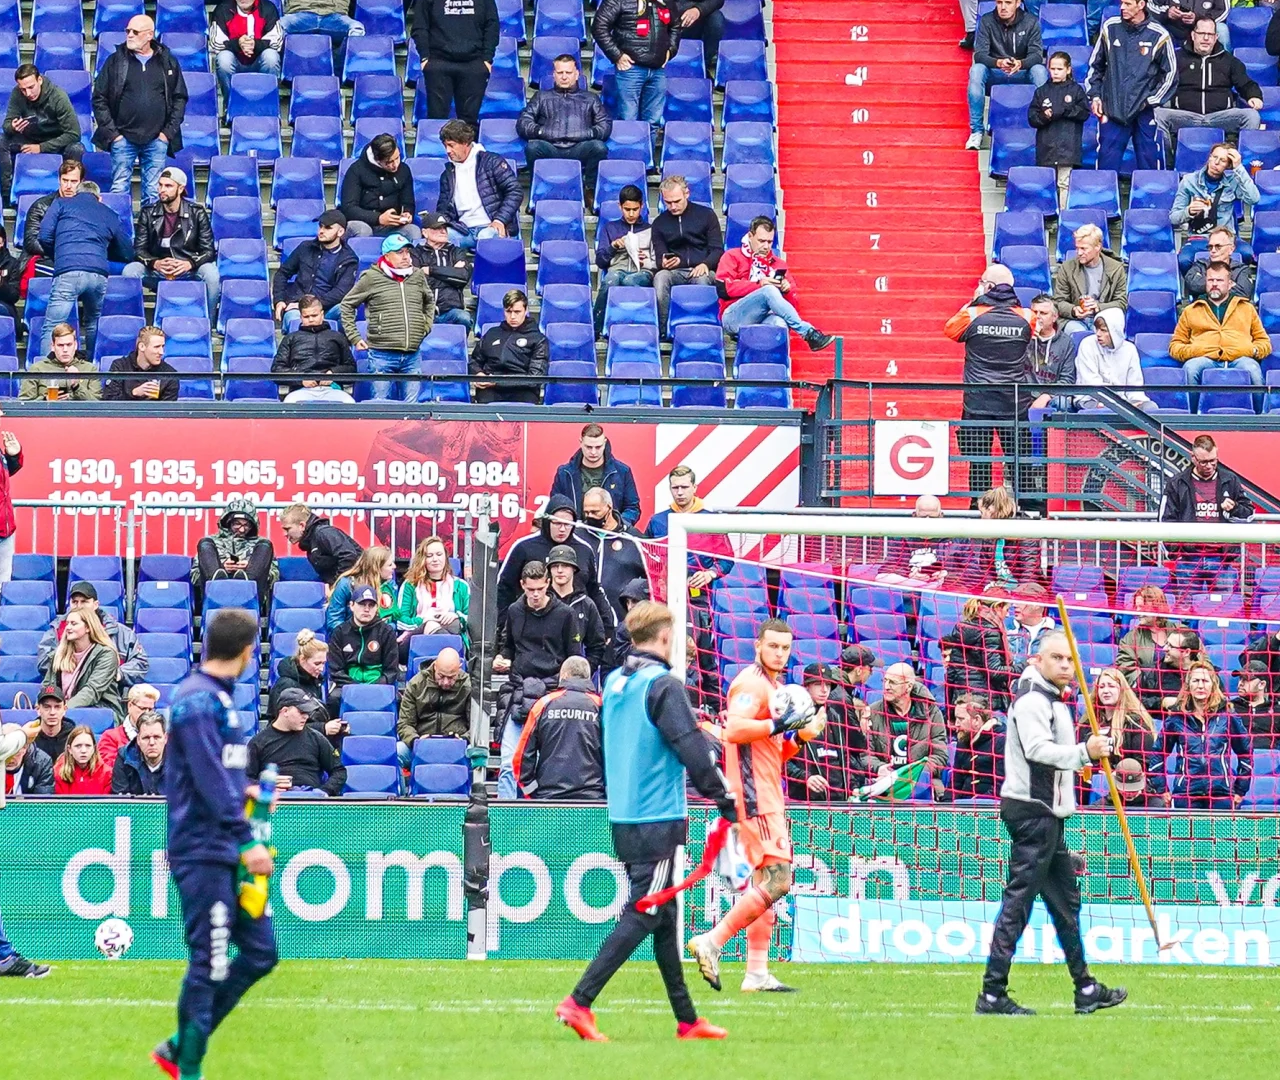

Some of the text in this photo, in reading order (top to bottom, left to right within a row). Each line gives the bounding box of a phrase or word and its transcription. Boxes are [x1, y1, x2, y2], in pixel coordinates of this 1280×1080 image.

[849, 25, 869, 42] 12
[851, 108, 869, 125] 10
[862, 150, 874, 167] 9
[866, 191, 879, 208] 8
[870, 233, 882, 250] 7
[880, 318, 892, 335] 5
[976, 322, 1024, 337] SECURITY
[885, 359, 898, 376] 4
[885, 400, 899, 418] 3
[889, 435, 934, 480] G
[49, 457, 519, 490] 1930, 1935, 1965, 1969, 1980, 1984
[546, 708, 600, 722] SECURITY
